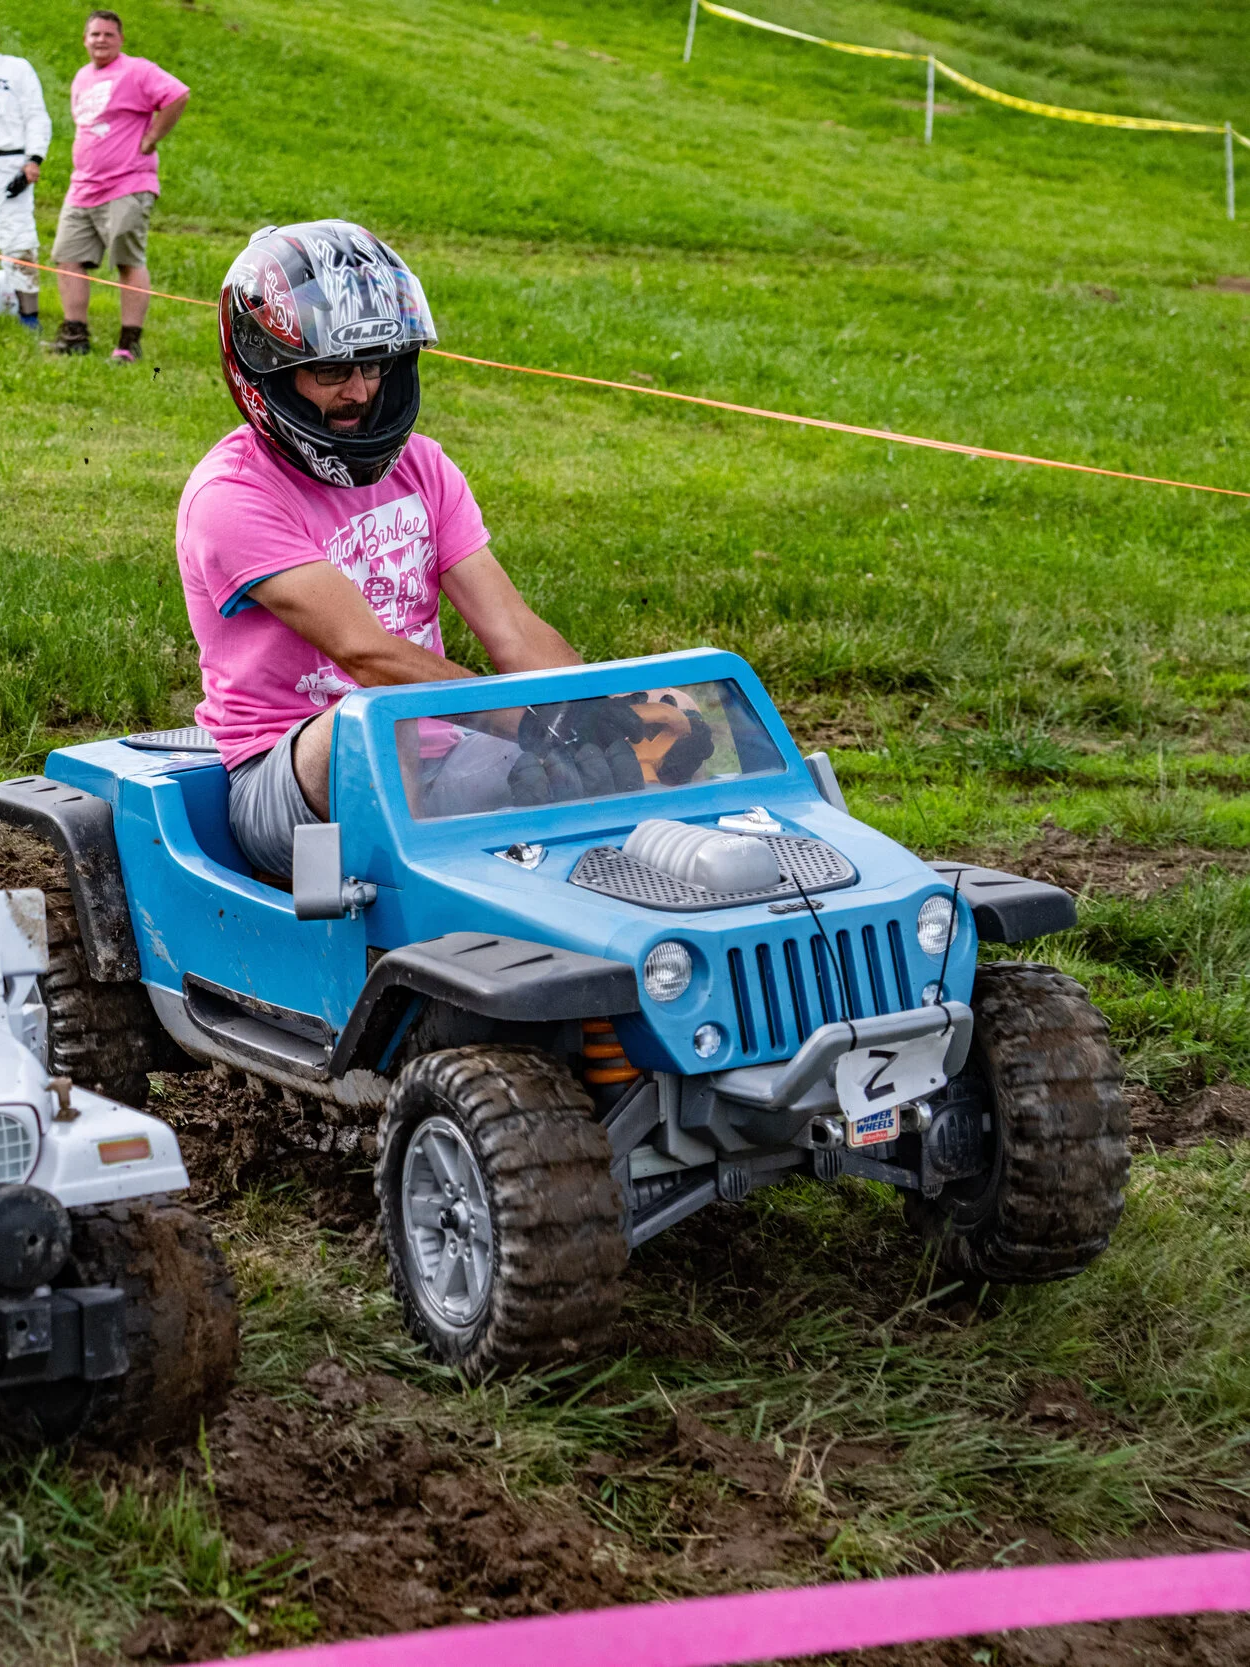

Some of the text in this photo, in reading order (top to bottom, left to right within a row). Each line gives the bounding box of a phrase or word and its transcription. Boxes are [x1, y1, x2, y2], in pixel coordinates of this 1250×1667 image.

[344, 323, 394, 340] HJC
[357, 506, 427, 556] Barbee
[856, 1117, 895, 1134] WHEELS
